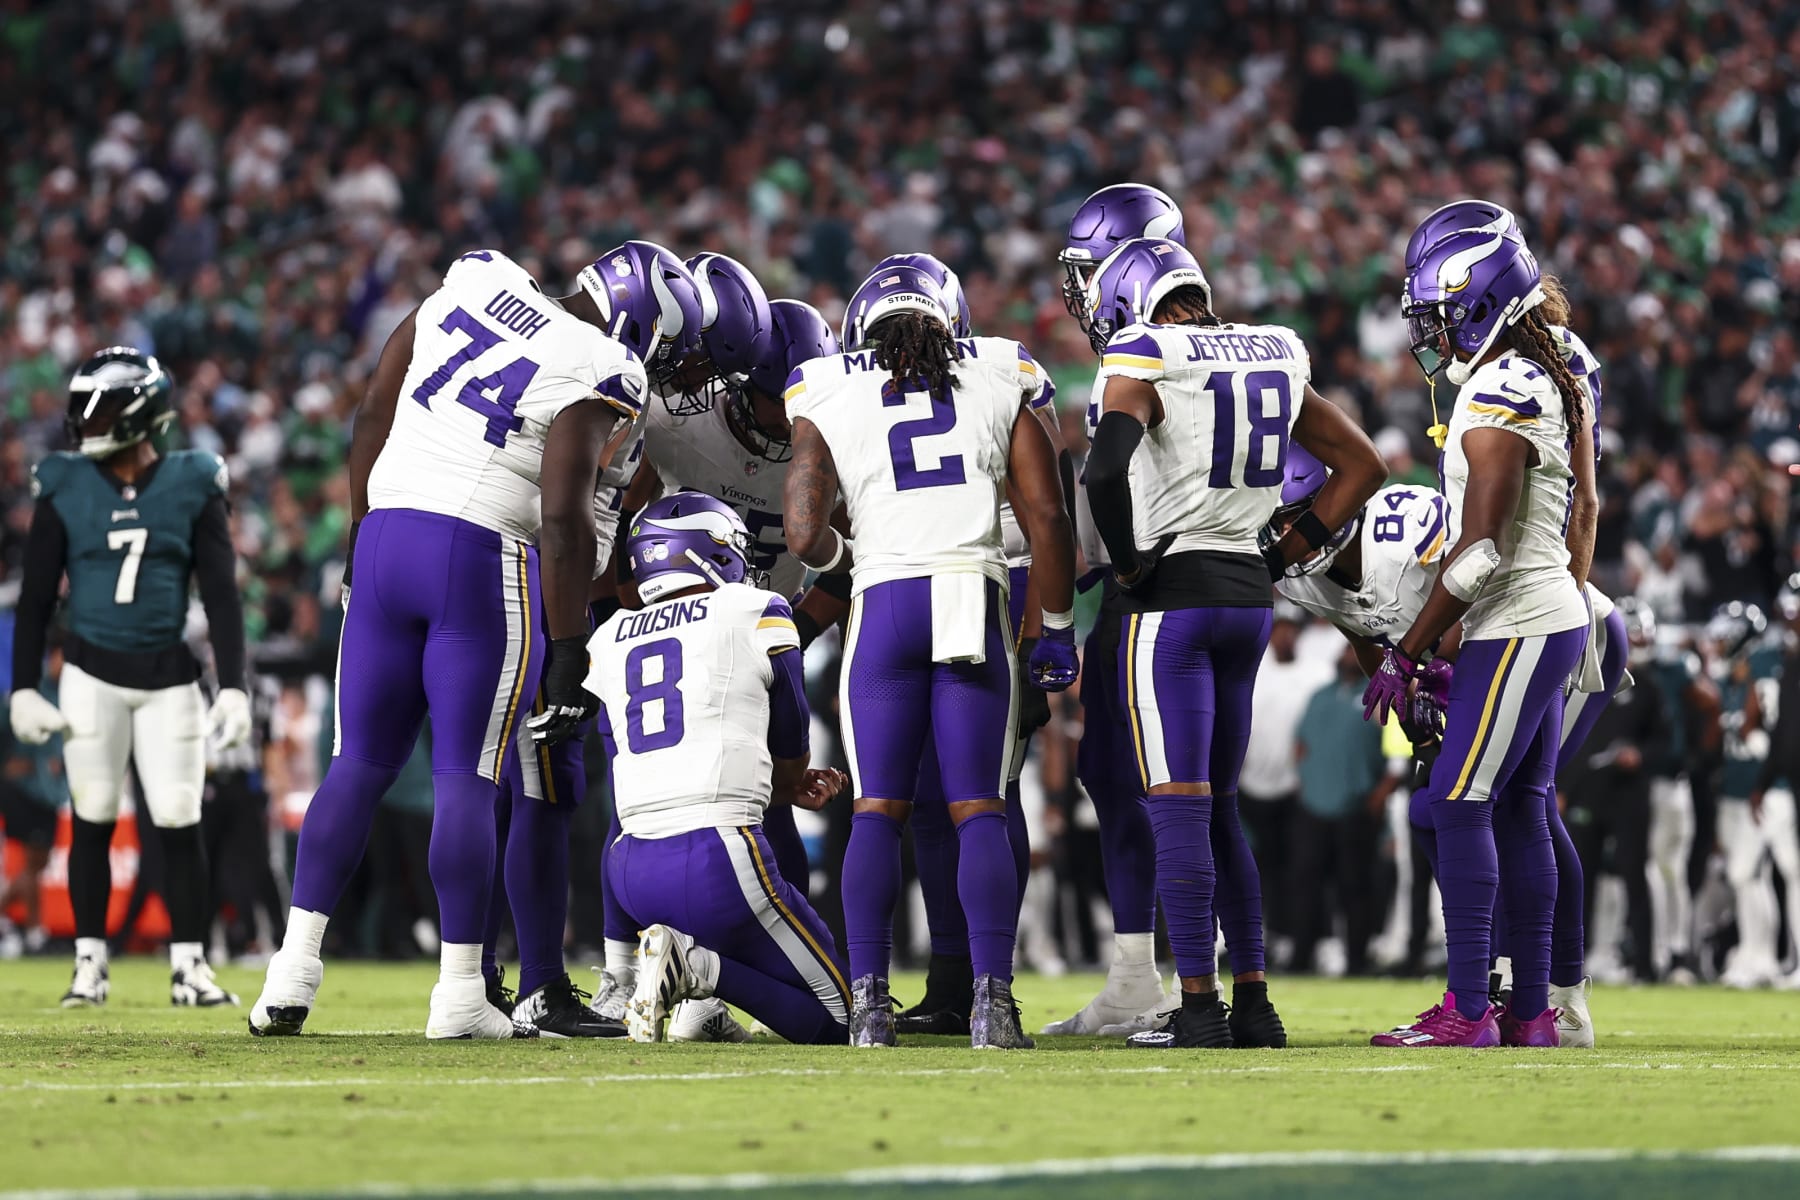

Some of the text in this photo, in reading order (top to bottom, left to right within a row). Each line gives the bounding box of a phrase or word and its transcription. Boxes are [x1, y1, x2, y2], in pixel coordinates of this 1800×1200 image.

[484, 289, 551, 340] UDOH
[888, 295, 936, 310] STOP HATE
[411, 305, 541, 449] 74
[1186, 334, 1295, 363] JEFFERSON
[881, 374, 967, 491] 2
[1203, 370, 1292, 489] 18
[1373, 490, 1420, 542] 84
[107, 527, 148, 604] 7
[614, 596, 710, 643] COUSINS
[625, 636, 685, 755] 8
